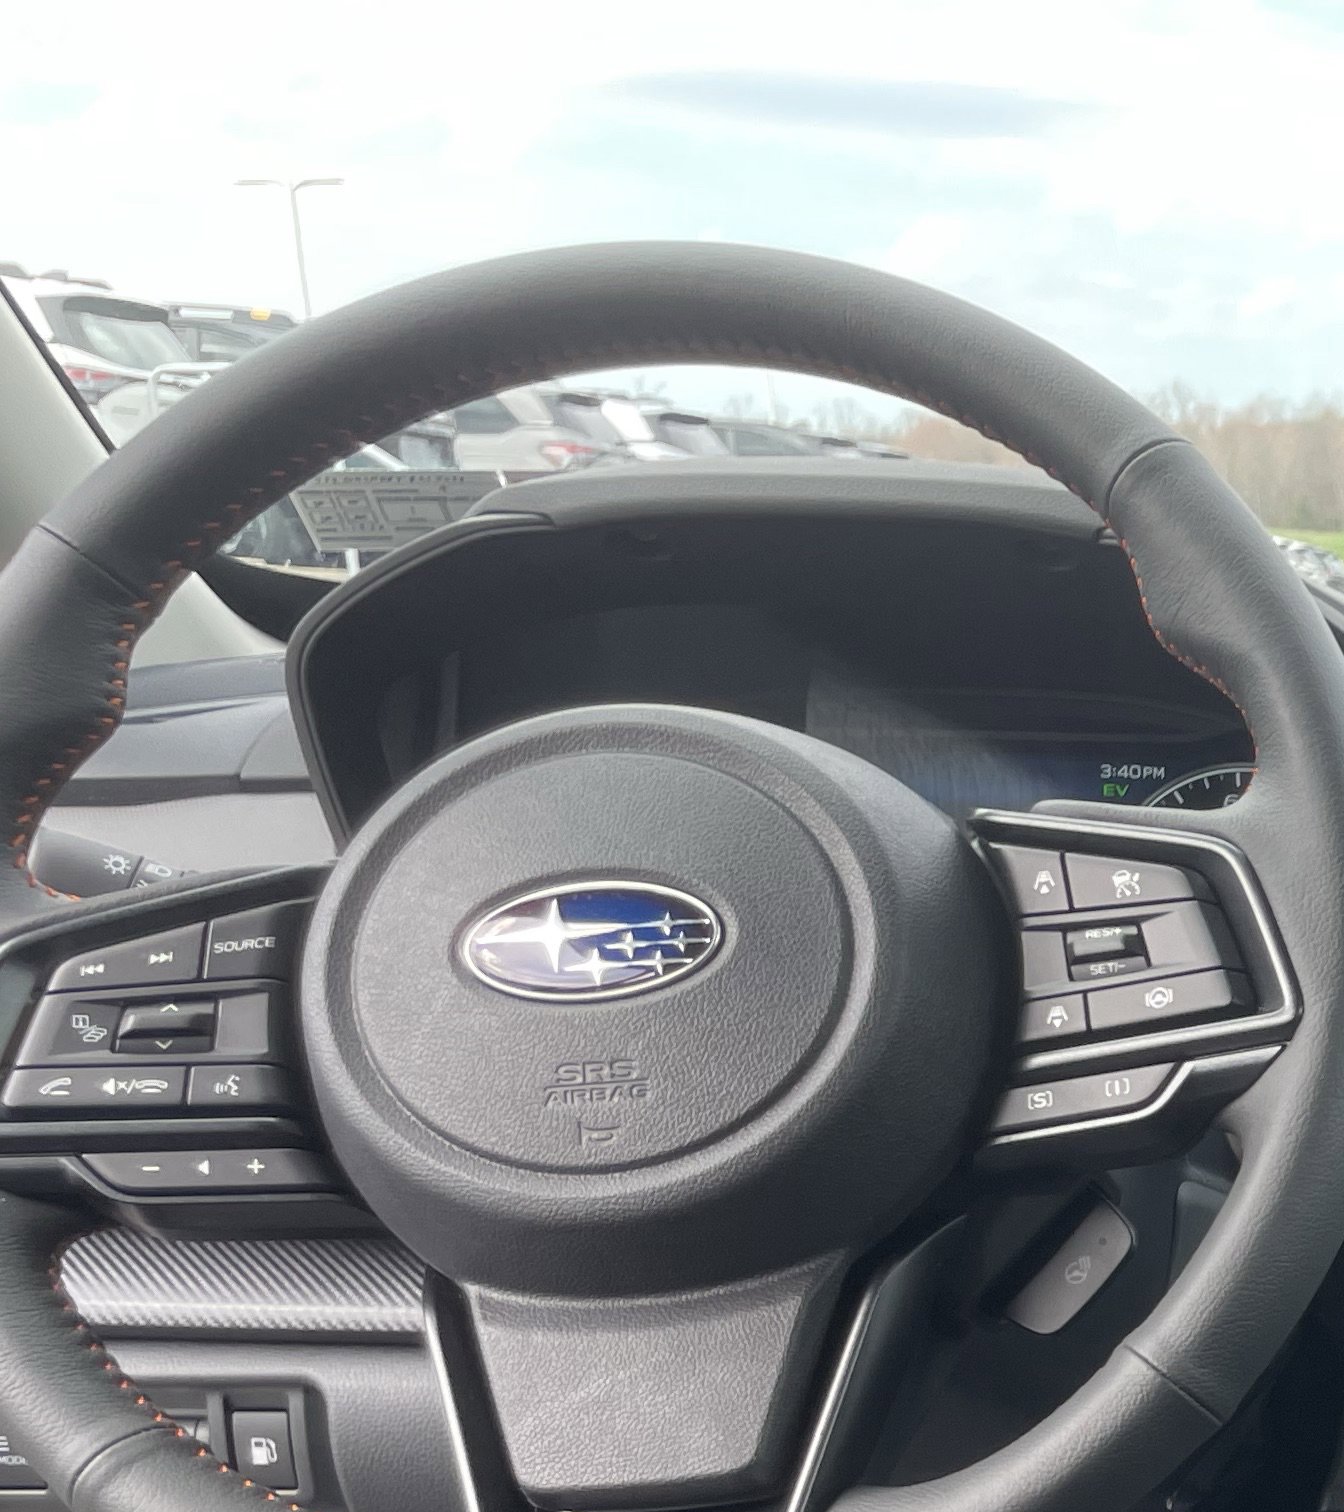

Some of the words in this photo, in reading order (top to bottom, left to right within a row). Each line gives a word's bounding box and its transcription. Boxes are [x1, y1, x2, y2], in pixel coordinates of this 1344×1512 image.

[1104, 784, 1129, 797] EV
[213, 936, 276, 954] SOURCE
[554, 1058, 640, 1084] SRS
[543, 1083, 650, 1108] AIRBAG
